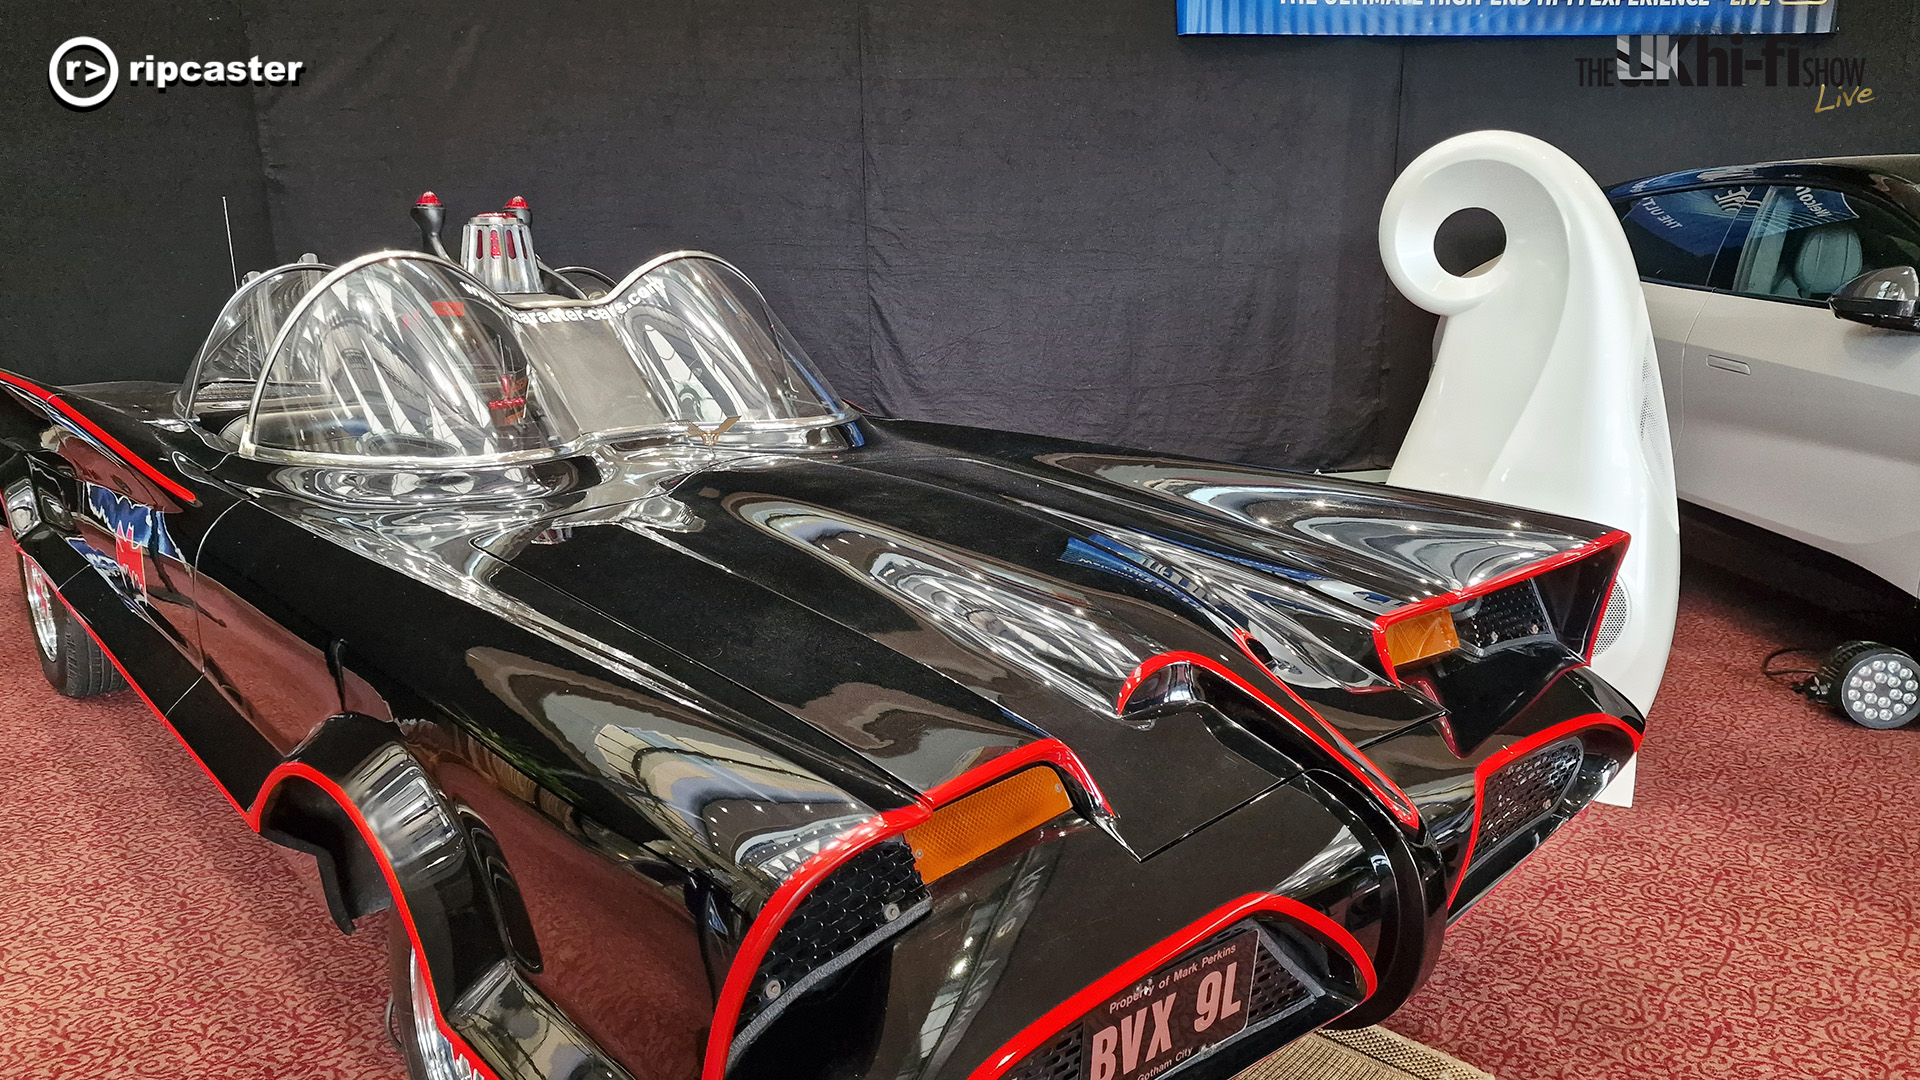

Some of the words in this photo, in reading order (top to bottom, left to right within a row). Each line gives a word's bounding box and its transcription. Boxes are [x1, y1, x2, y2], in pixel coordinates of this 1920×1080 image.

[1158, 974, 1171, 990] of
[1173, 962, 1199, 983] Mark
[1201, 943, 1237, 968] Perkins
[1089, 991, 1178, 1080] BVX
[1193, 961, 1242, 1033] 9L
[1136, 1058, 1173, 1080] Gotham
[1174, 1046, 1194, 1063] City
